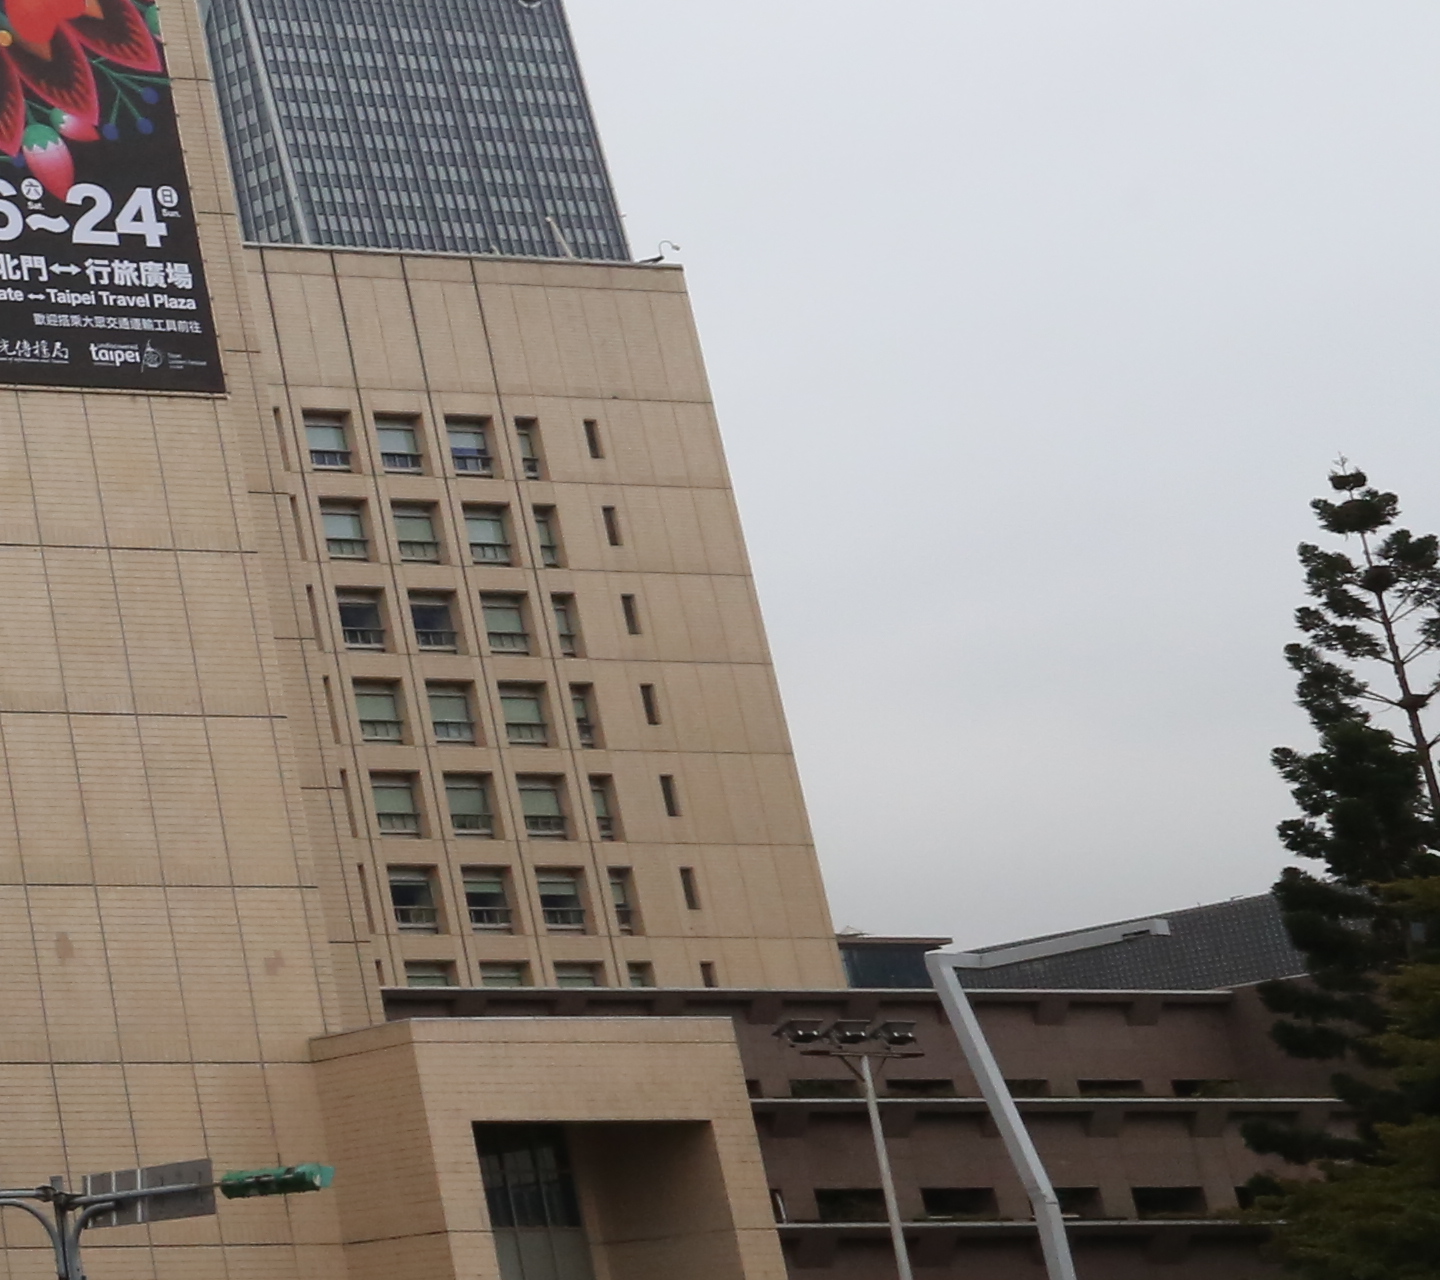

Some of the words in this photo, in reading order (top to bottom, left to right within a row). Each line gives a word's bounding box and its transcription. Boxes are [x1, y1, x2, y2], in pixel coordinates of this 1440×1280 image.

[45, 288, 96, 307] Taipei
[98, 291, 150, 308] Travel
[153, 294, 197, 310] Plaza
